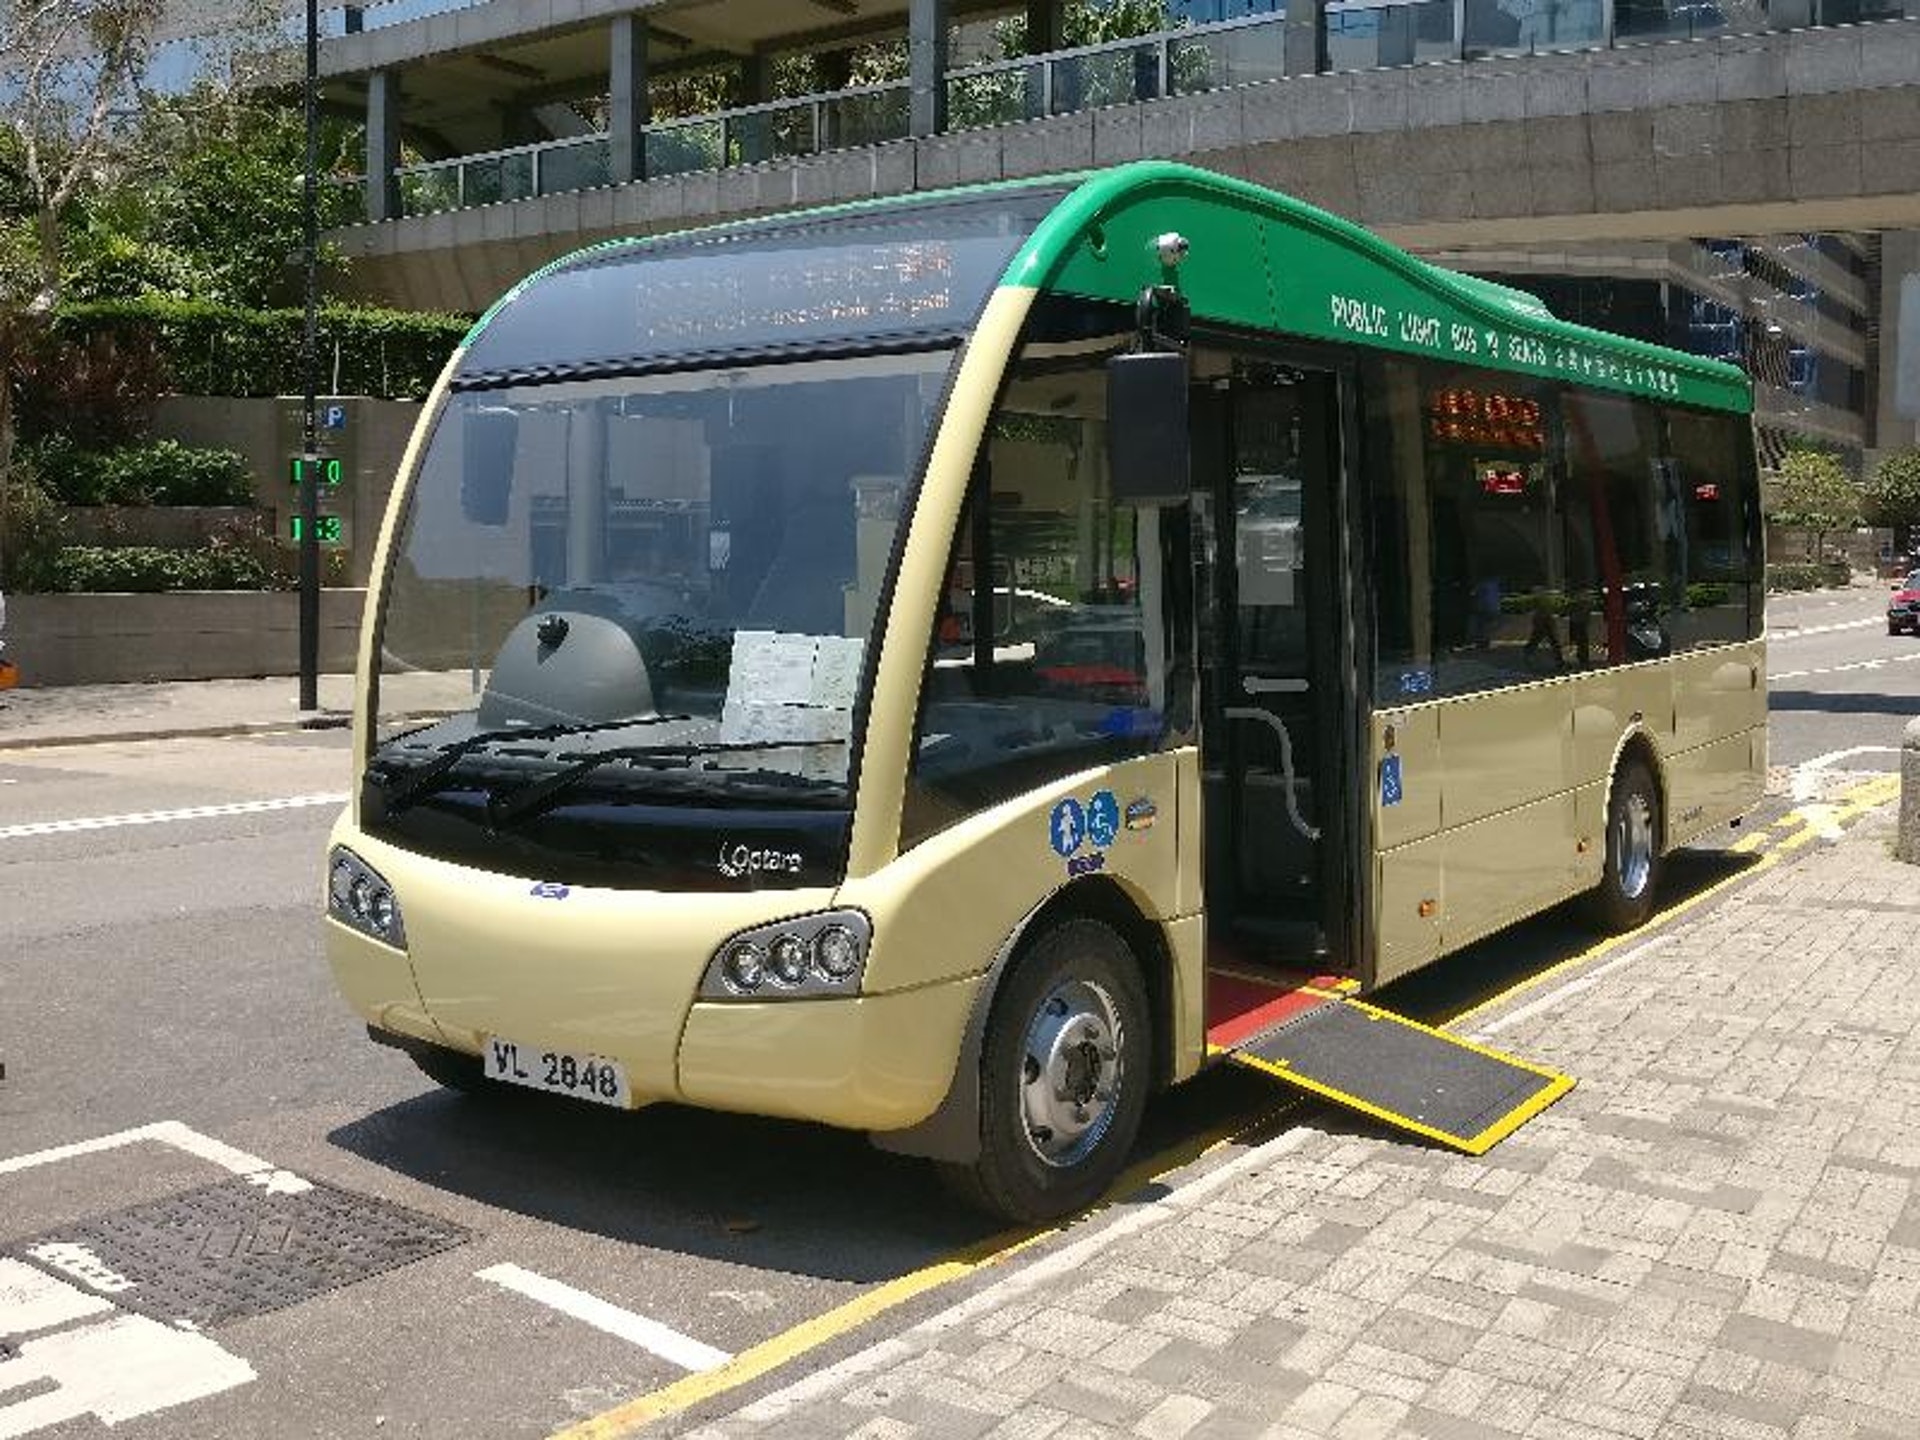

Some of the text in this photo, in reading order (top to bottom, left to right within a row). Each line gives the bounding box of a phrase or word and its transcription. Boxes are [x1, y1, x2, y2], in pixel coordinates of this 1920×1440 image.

[1332, 294, 1388, 337] PUBLIC
[1399, 311, 1440, 348] LIGHT
[1451, 322, 1477, 353] BUS
[1508, 333, 1546, 366] SEATS
[493, 1041, 618, 1098] VL 2848
